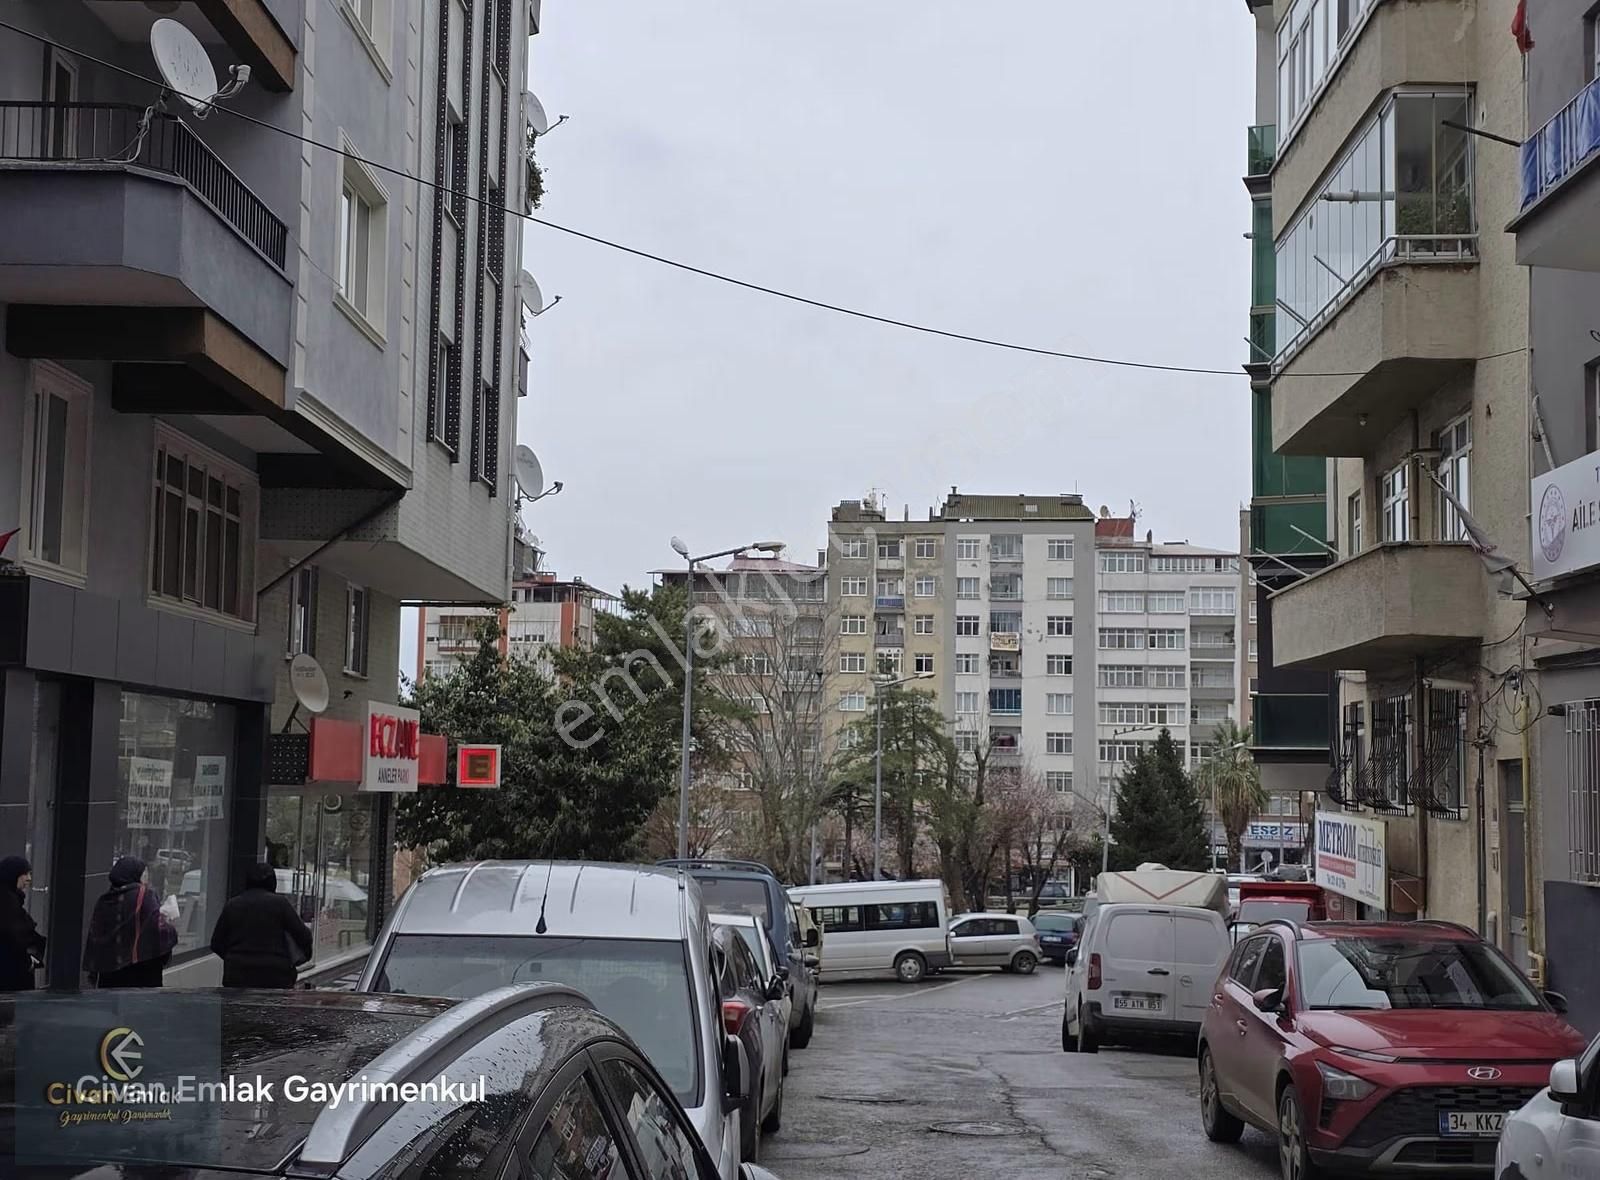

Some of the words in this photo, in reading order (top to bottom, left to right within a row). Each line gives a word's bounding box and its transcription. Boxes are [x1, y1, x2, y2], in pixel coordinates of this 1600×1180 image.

[1572, 499, 1596, 532] AİLE
[1450, 1114, 1468, 1131] 34
[1476, 1114, 1502, 1131] KKZ
